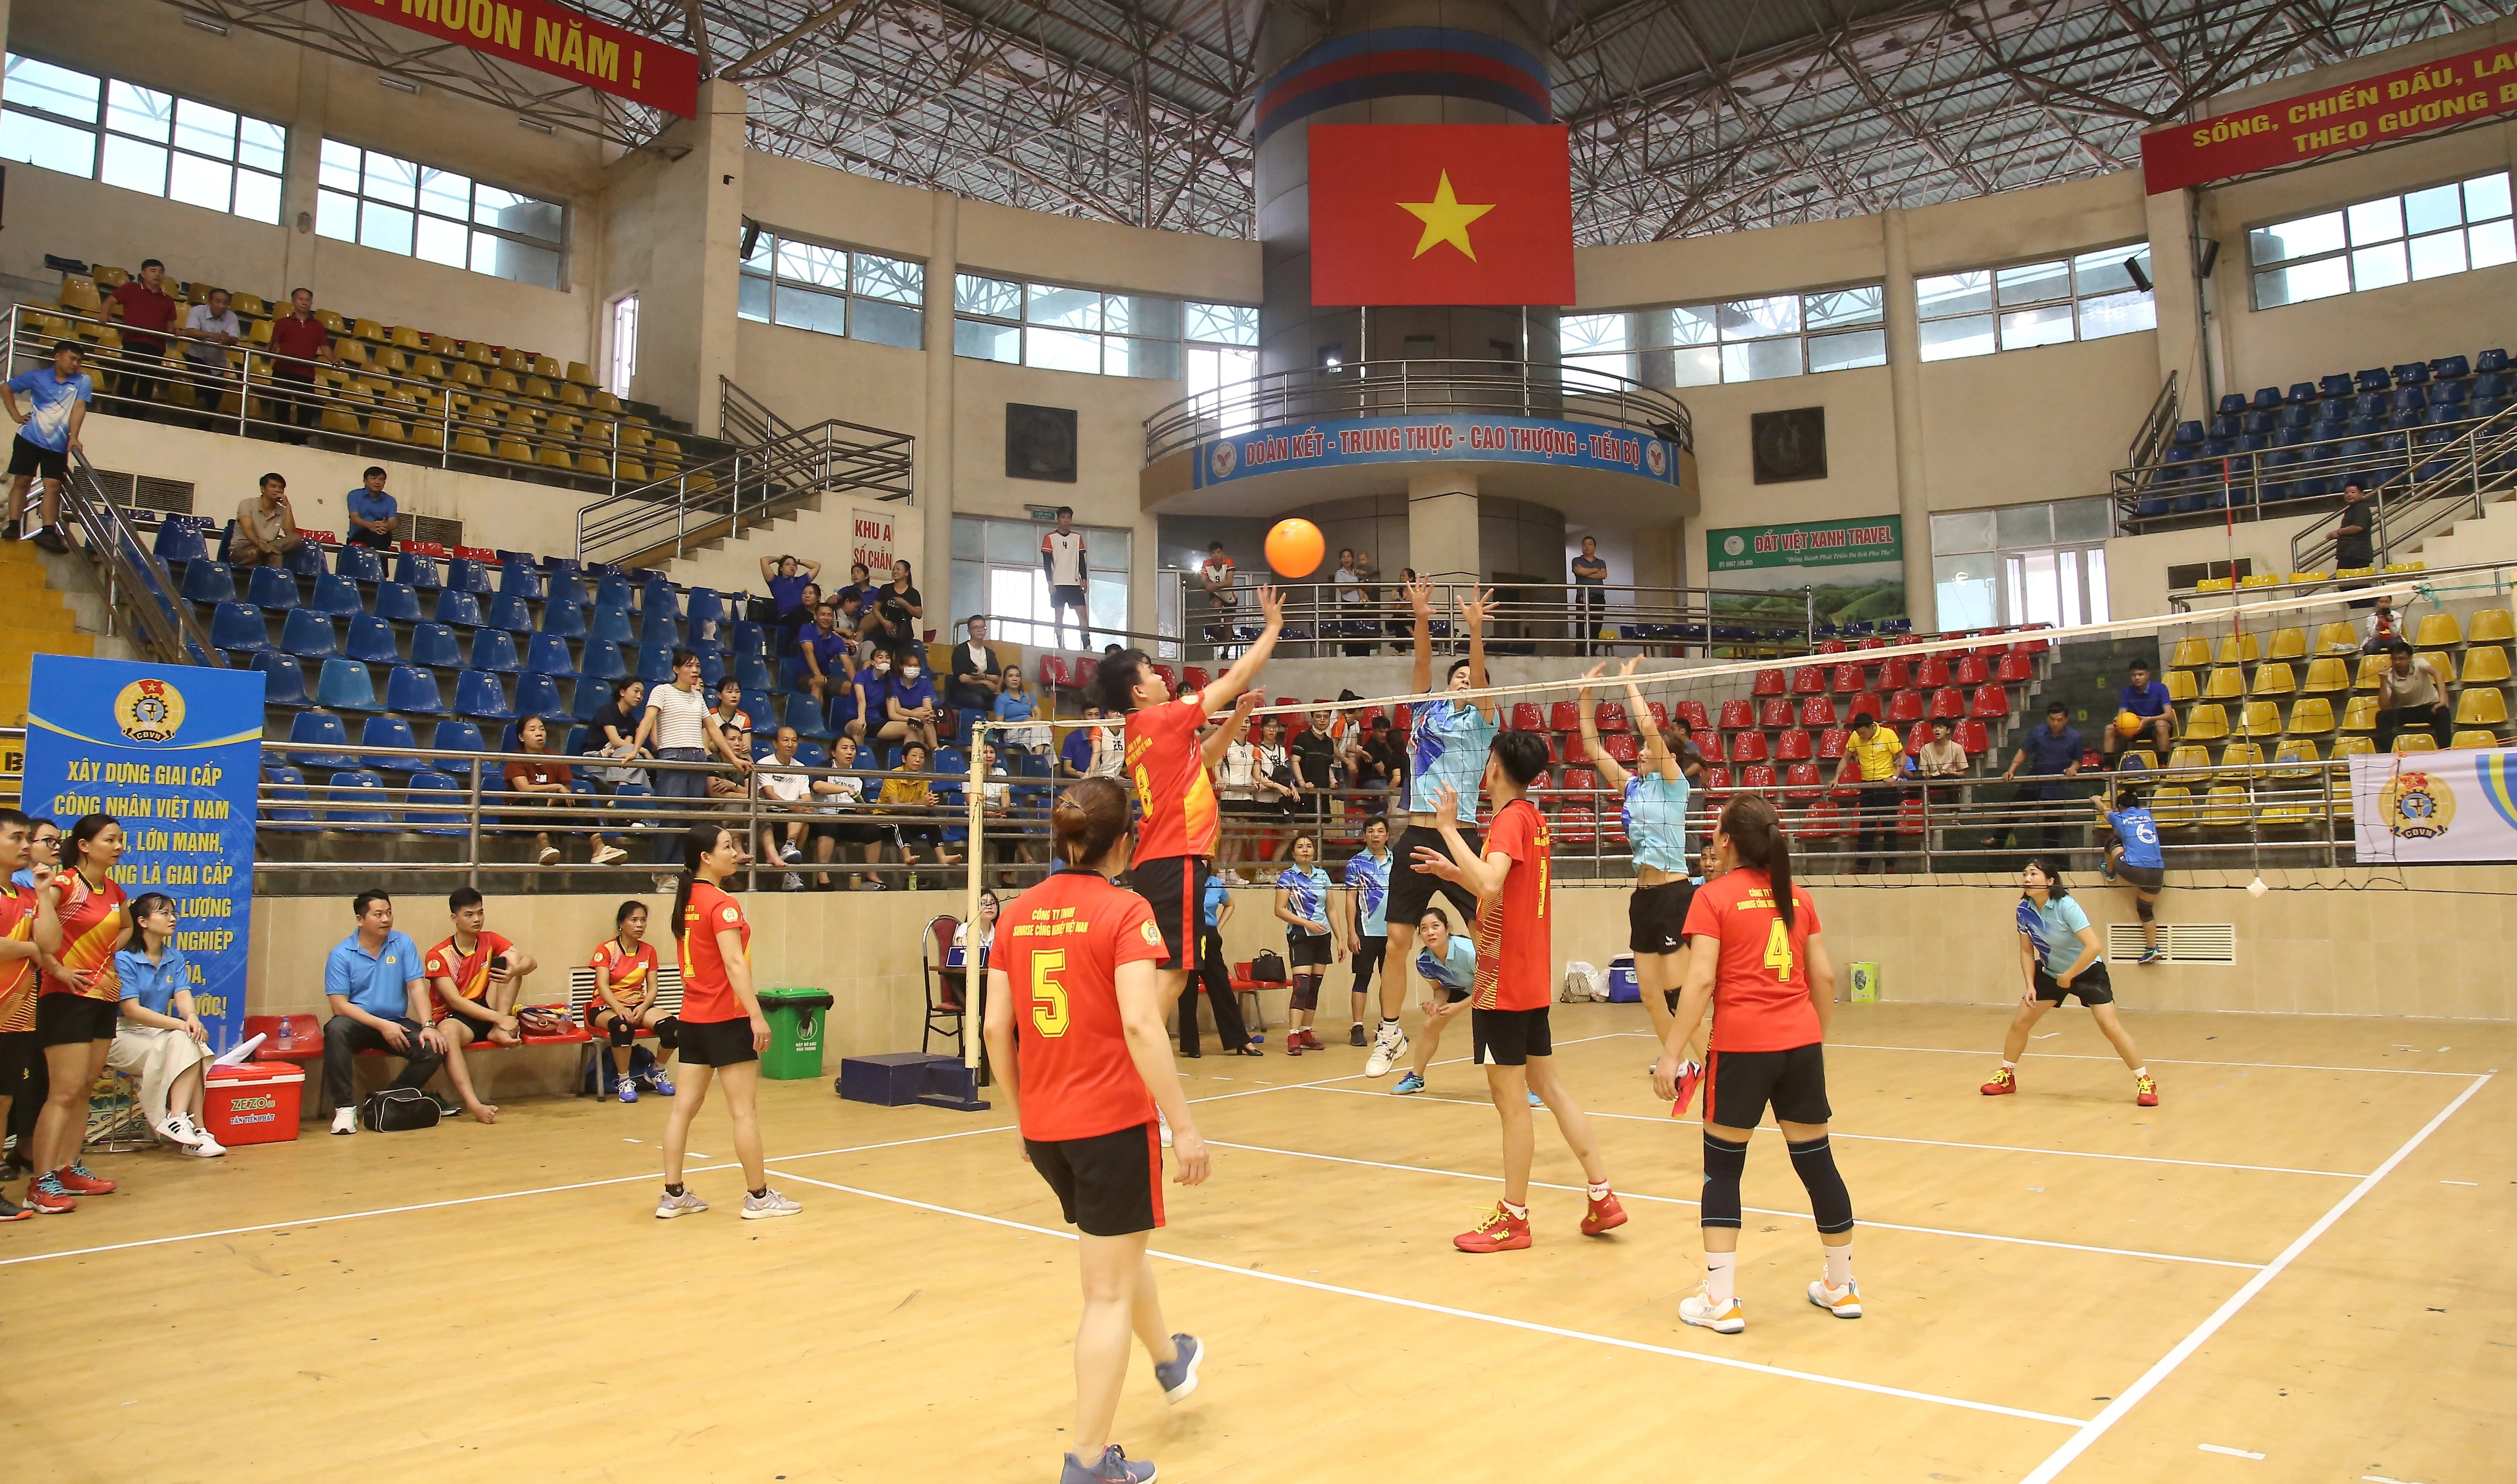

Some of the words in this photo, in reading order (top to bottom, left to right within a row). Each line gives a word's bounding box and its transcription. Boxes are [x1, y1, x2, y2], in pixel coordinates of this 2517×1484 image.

[534, 17, 619, 82] NĂM
[632, 51, 642, 89] !
[2193, 114, 2280, 148] SỐNG,
[2288, 86, 2379, 125] CHIẾN
[2388, 67, 2463, 100] ĐẤU,
[2293, 120, 2368, 153] THEO
[2379, 91, 2488, 132] GƯƠNG
[1245, 435, 1288, 466] ĐOÀN
[1292, 426, 1324, 459] KẾT
[1339, 428, 1401, 454] TRUNG
[1405, 424, 1454, 455] THỰC
[1470, 426, 1506, 450] CAO
[1510, 428, 1577, 458] THƯỢNG
[1589, 430, 1621, 463] TIẾN
[1623, 438, 1640, 470] BỘ
[855, 519, 879, 539] KHU
[883, 525, 891, 542] A
[1754, 529, 1778, 553] ĐẤT
[1781, 530, 1808, 553] VIỆT
[1810, 529, 1845, 549] XANH
[1847, 526, 1894, 545] TRAVEL
[854, 544, 866, 564] SỐ
[868, 546, 892, 570] CHẴN
[2097, 677, 2106, 689] E
[2078, 710, 2088, 721] D
[1113, 740, 1123, 751] 26
[6, 752, 23, 771] B
[67, 757, 102, 782] XÂY
[105, 761, 151, 787] DỰNG
[155, 764, 186, 785] GIAI
[191, 760, 222, 786] CẤP
[54, 791, 101, 816] CÔNG
[106, 794, 152, 818] NHÂN
[156, 795, 190, 823] VIỆT
[193, 799, 230, 819] NAM
[137, 828, 169, 851] LỚN
[172, 832, 224, 856] MẠNH,
[2136, 824, 2156, 844] 6
[142, 861, 161, 885] LÀ
[166, 865, 198, 885] GIAI
[202, 859, 233, 885] CẤP
[1736, 899, 1757, 911] SUNRISE
[1748, 888, 1763, 897] CÔNG
[181, 896, 232, 922] LƯỢNG
[1031, 907, 1051, 921] CÔNG
[1052, 909, 1061, 921] TY
[177, 927, 234, 954] NGHIỆP
[1012, 924, 1034, 937] SUNRISE
[1035, 922, 1051, 936] CÔNG
[1065, 919, 1075, 935] VIỆT
[682, 928, 696, 977] 1
[1764, 917, 1793, 982] 4
[1031, 948, 1070, 1038] 5
[230, 1097, 267, 1112] ZEZO
